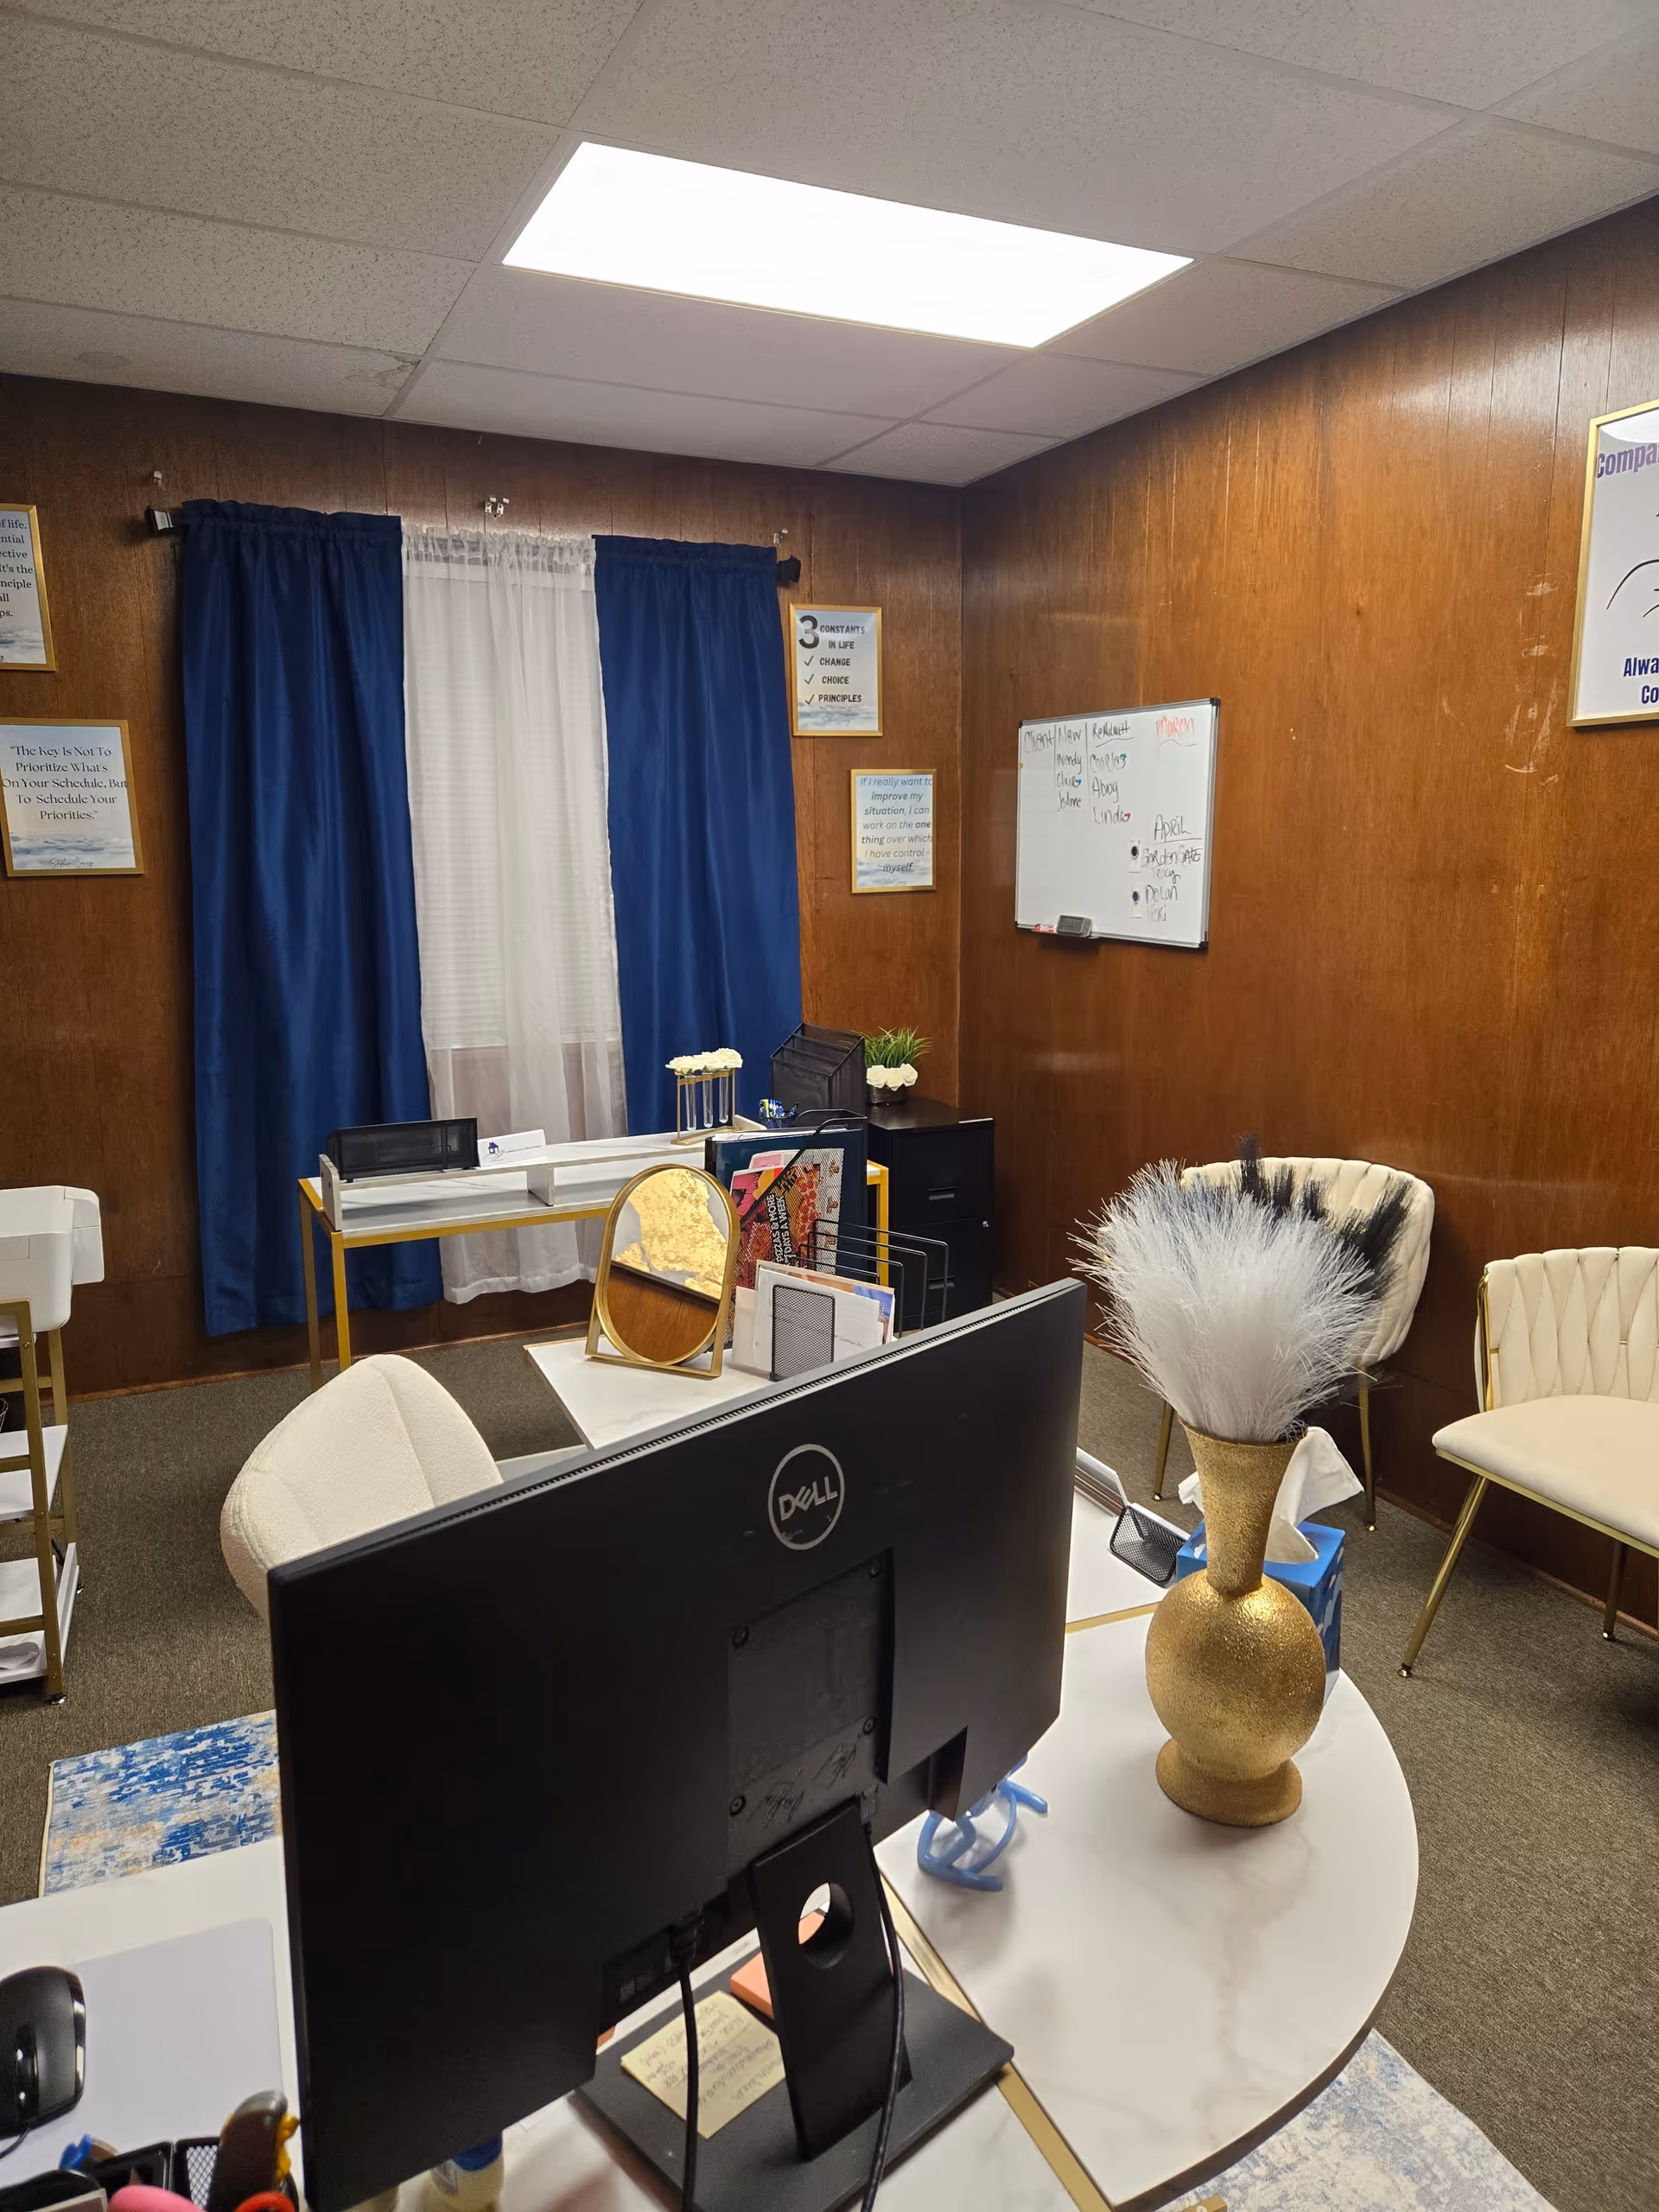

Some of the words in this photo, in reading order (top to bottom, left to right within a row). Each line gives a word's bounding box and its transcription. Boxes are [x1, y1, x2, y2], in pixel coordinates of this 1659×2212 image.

[8, 518, 27, 529] life.
[16, 564, 34, 574] the
[798, 615, 820, 649] 3
[820, 625, 866, 635] CONSTANTS
[829, 640, 836, 649] IN
[819, 658, 850, 666] CHANGE
[822, 676, 849, 684] CHOICE
[818, 694, 862, 702] PRINCIPLES
[39, 747, 60, 758] Key
[63, 747, 72, 756] Is
[74, 747, 94, 756] Not
[97, 747, 111, 756] To
[16, 762, 68, 772] Prioritize
[70, 762, 108, 772] What's
[2, 779, 20, 788] On
[22, 779, 49, 788] Your
[109, 779, 128, 788] But
[860, 778, 868, 787] If
[868, 778, 872, 786] I
[874, 778, 899, 788] really
[900, 778, 923, 786] want
[16, 795, 31, 804] To
[36, 794, 88, 804] Schedule
[90, 795, 117, 804] Your
[871, 791, 908, 802] improve
[910, 793, 924, 802] my
[40, 810, 98, 820] Priorities."
[864, 806, 906, 816] situation,
[862, 821, 884, 830] work
[899, 821, 913, 830] the
[861, 836, 885, 846] thing
[907, 834, 933, 844] which
[893, 849, 925, 858] control
[766, 1194, 778, 1222] MORE
[776, 1195, 788, 1223] WEEK
[772, 1231, 784, 1262] PIZZAS
[781, 1231, 792, 1252] DAYS
[779, 1476, 838, 1522] DELL
